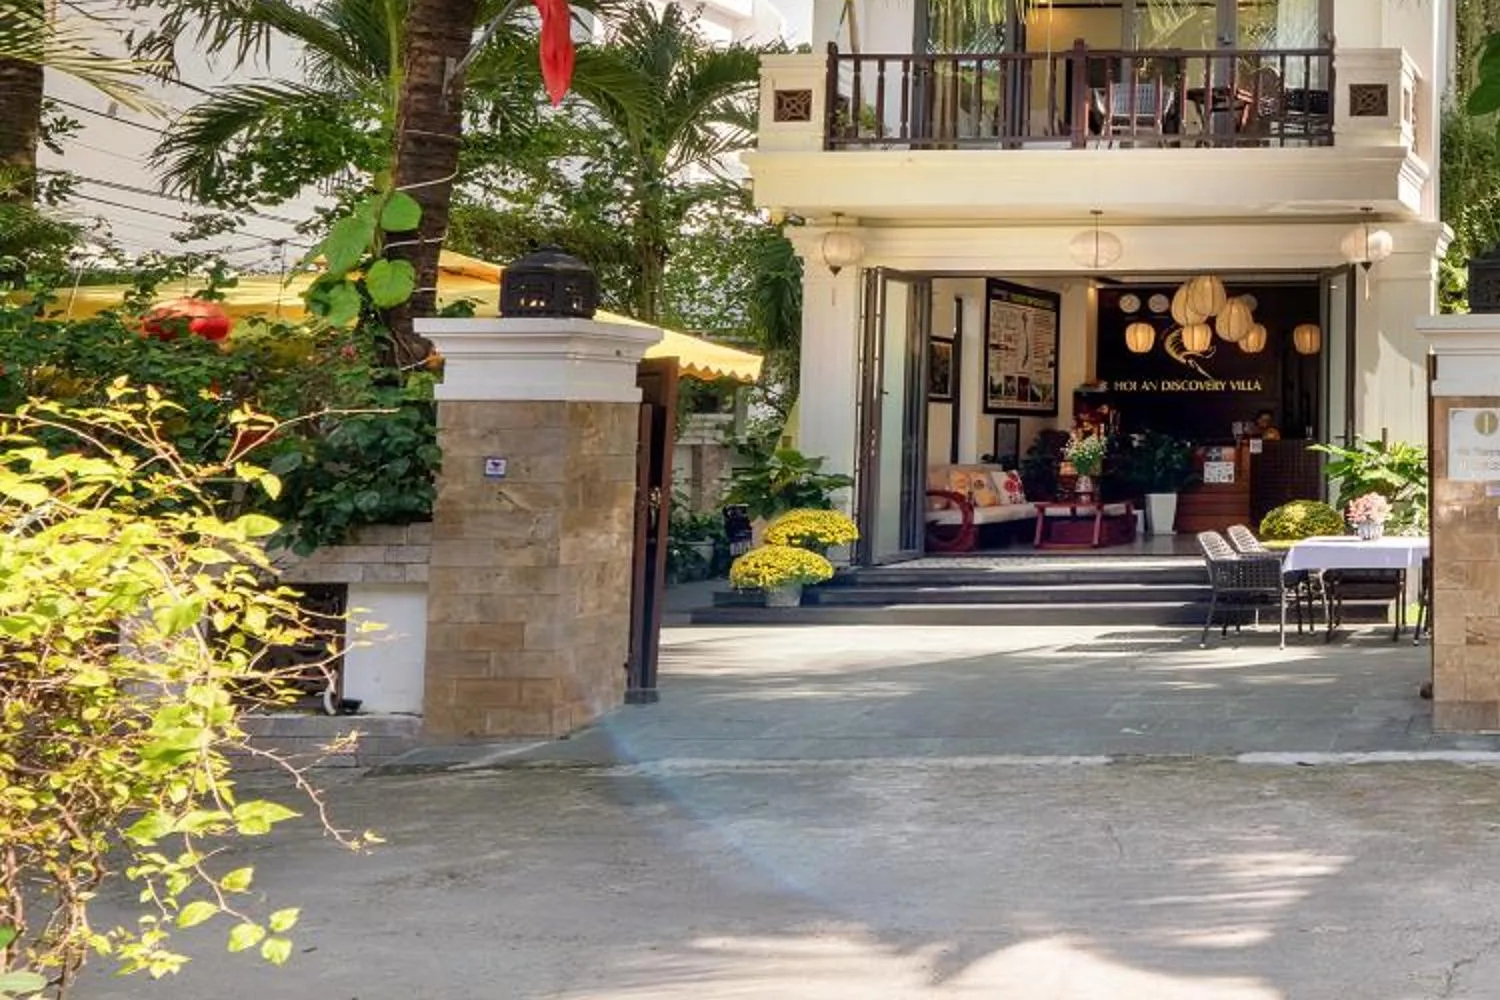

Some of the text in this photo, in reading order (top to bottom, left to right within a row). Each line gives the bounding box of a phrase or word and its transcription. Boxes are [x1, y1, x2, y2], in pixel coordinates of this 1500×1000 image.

[1141, 380, 1158, 392] AN
[1161, 380, 1226, 392] DISCOVERY
[1229, 379, 1262, 392] VILLA
